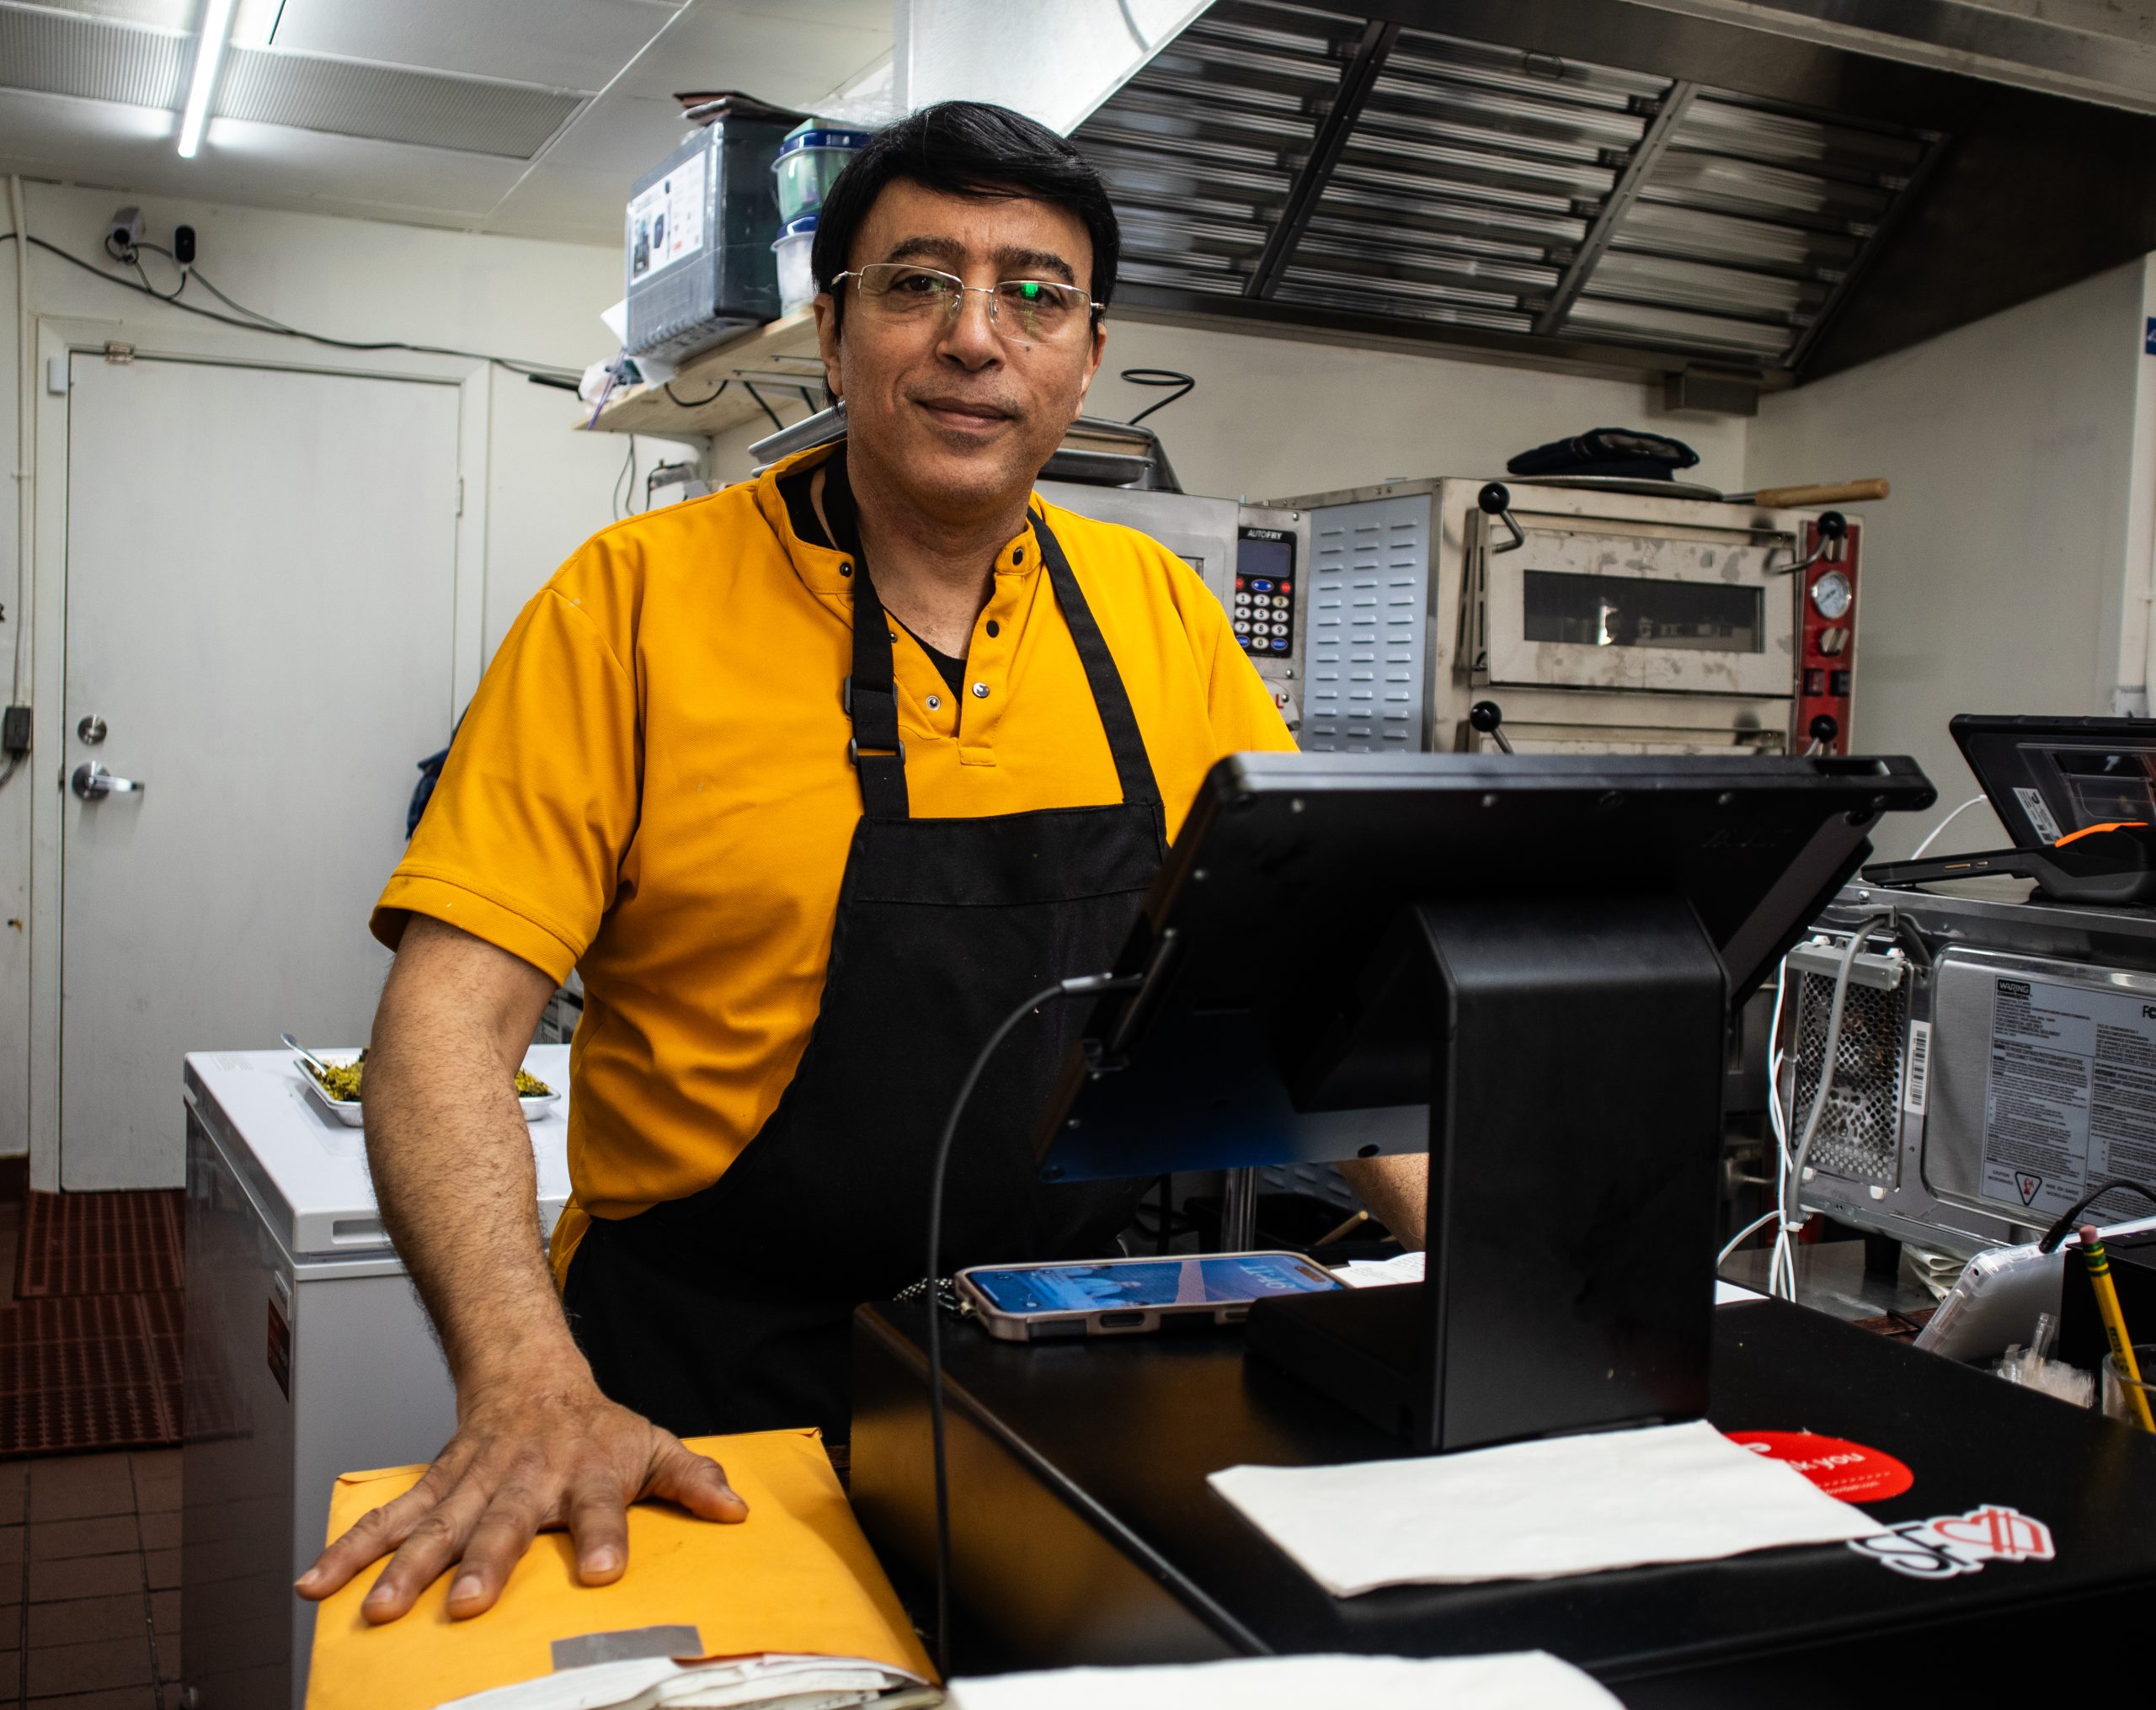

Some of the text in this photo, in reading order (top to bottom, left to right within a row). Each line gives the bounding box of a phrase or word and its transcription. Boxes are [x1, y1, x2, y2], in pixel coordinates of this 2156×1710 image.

[1247, 530, 1283, 540] AUTOFRY
[1999, 982, 2029, 994] WARING
[1812, 1452, 1865, 1470] you
